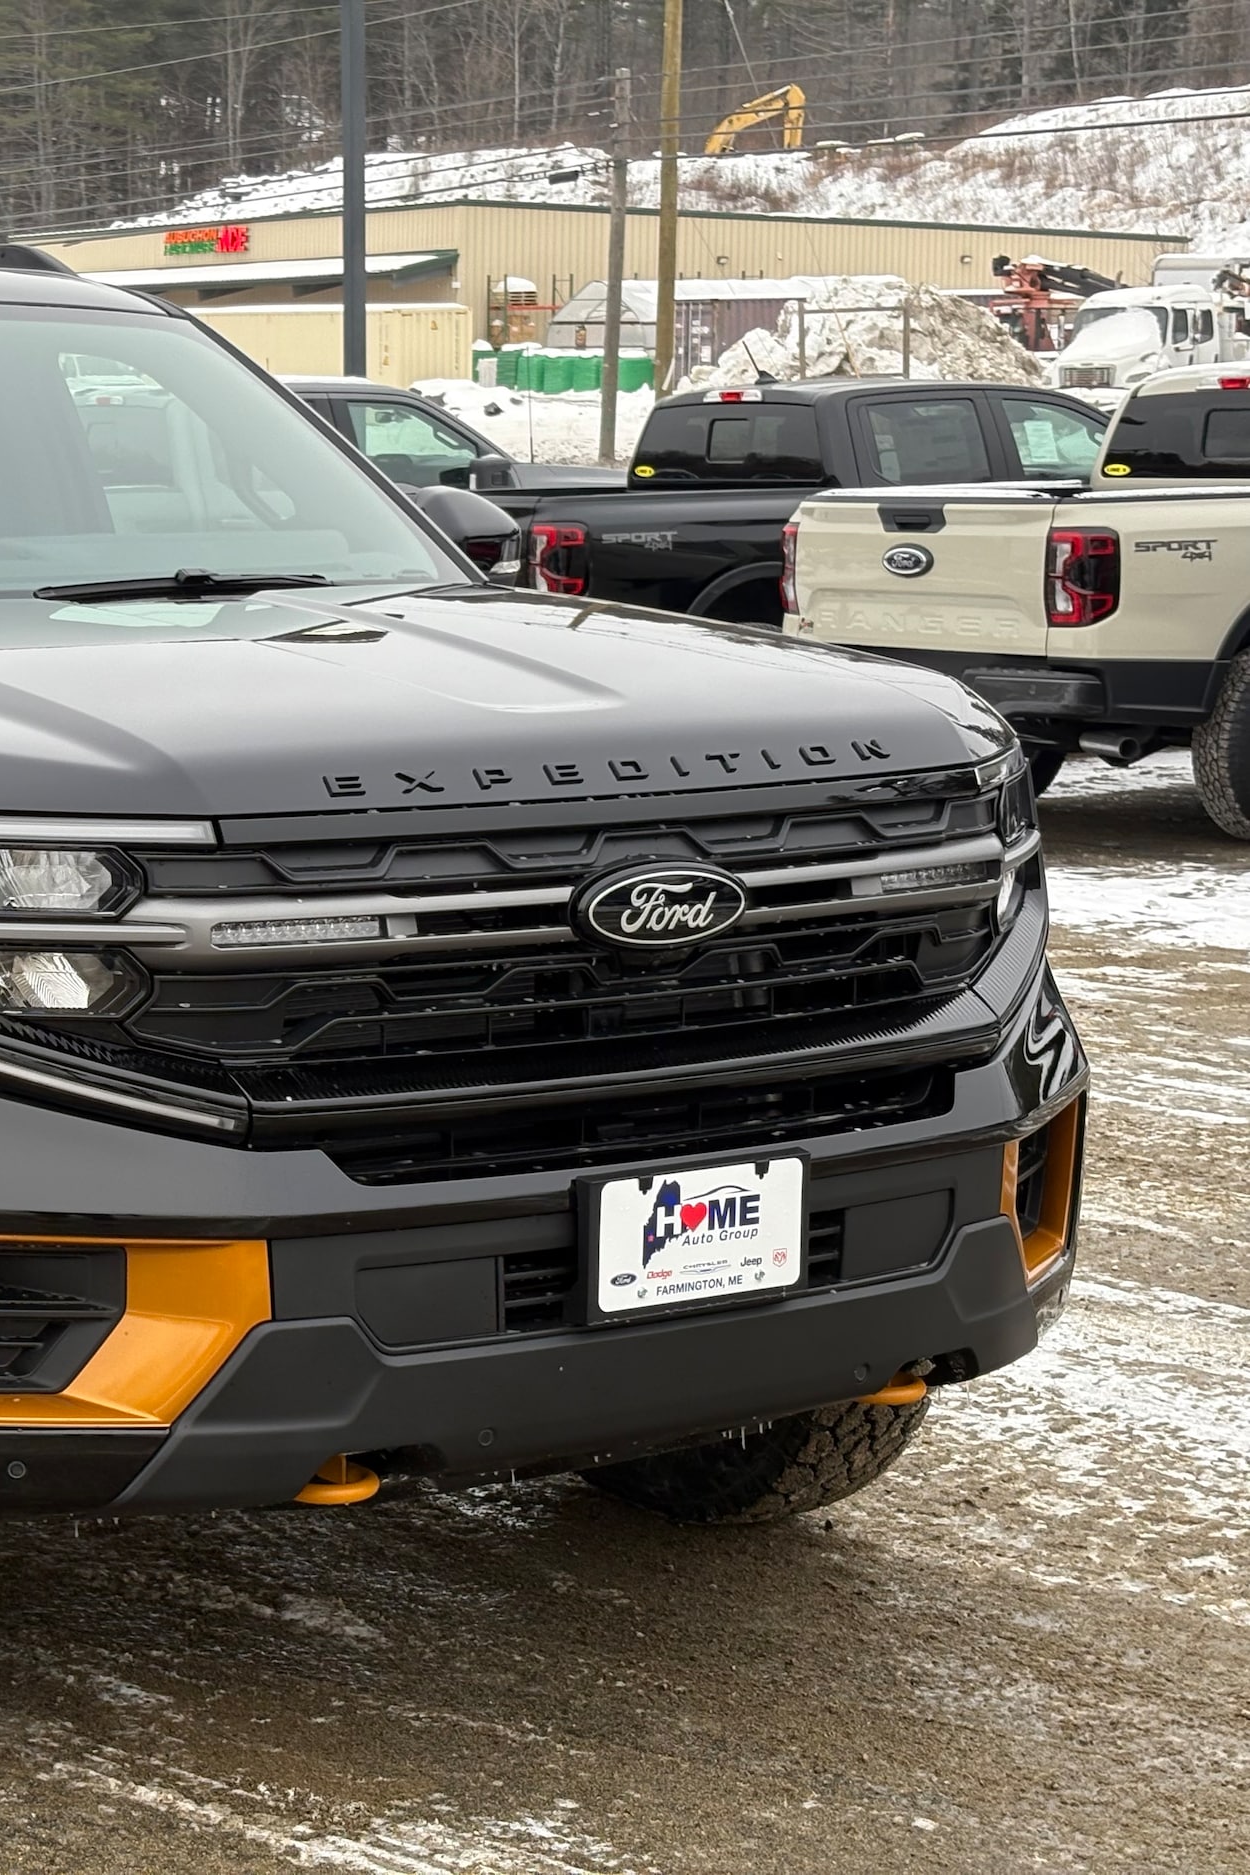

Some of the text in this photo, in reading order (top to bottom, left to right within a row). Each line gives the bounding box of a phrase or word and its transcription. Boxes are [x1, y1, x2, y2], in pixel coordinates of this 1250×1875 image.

[601, 530, 679, 544] SPORT
[1134, 539, 1218, 553] SPORT
[816, 609, 1022, 639] RANGER
[322, 738, 891, 798] EXPEDITION
[620, 882, 717, 934] Ford
[681, 1228, 759, 1247] Auto Group
[740, 1256, 763, 1268] Jeep
[646, 1269, 673, 1280] Dodge
[656, 1274, 743, 1297] FARMINGTON, ME
